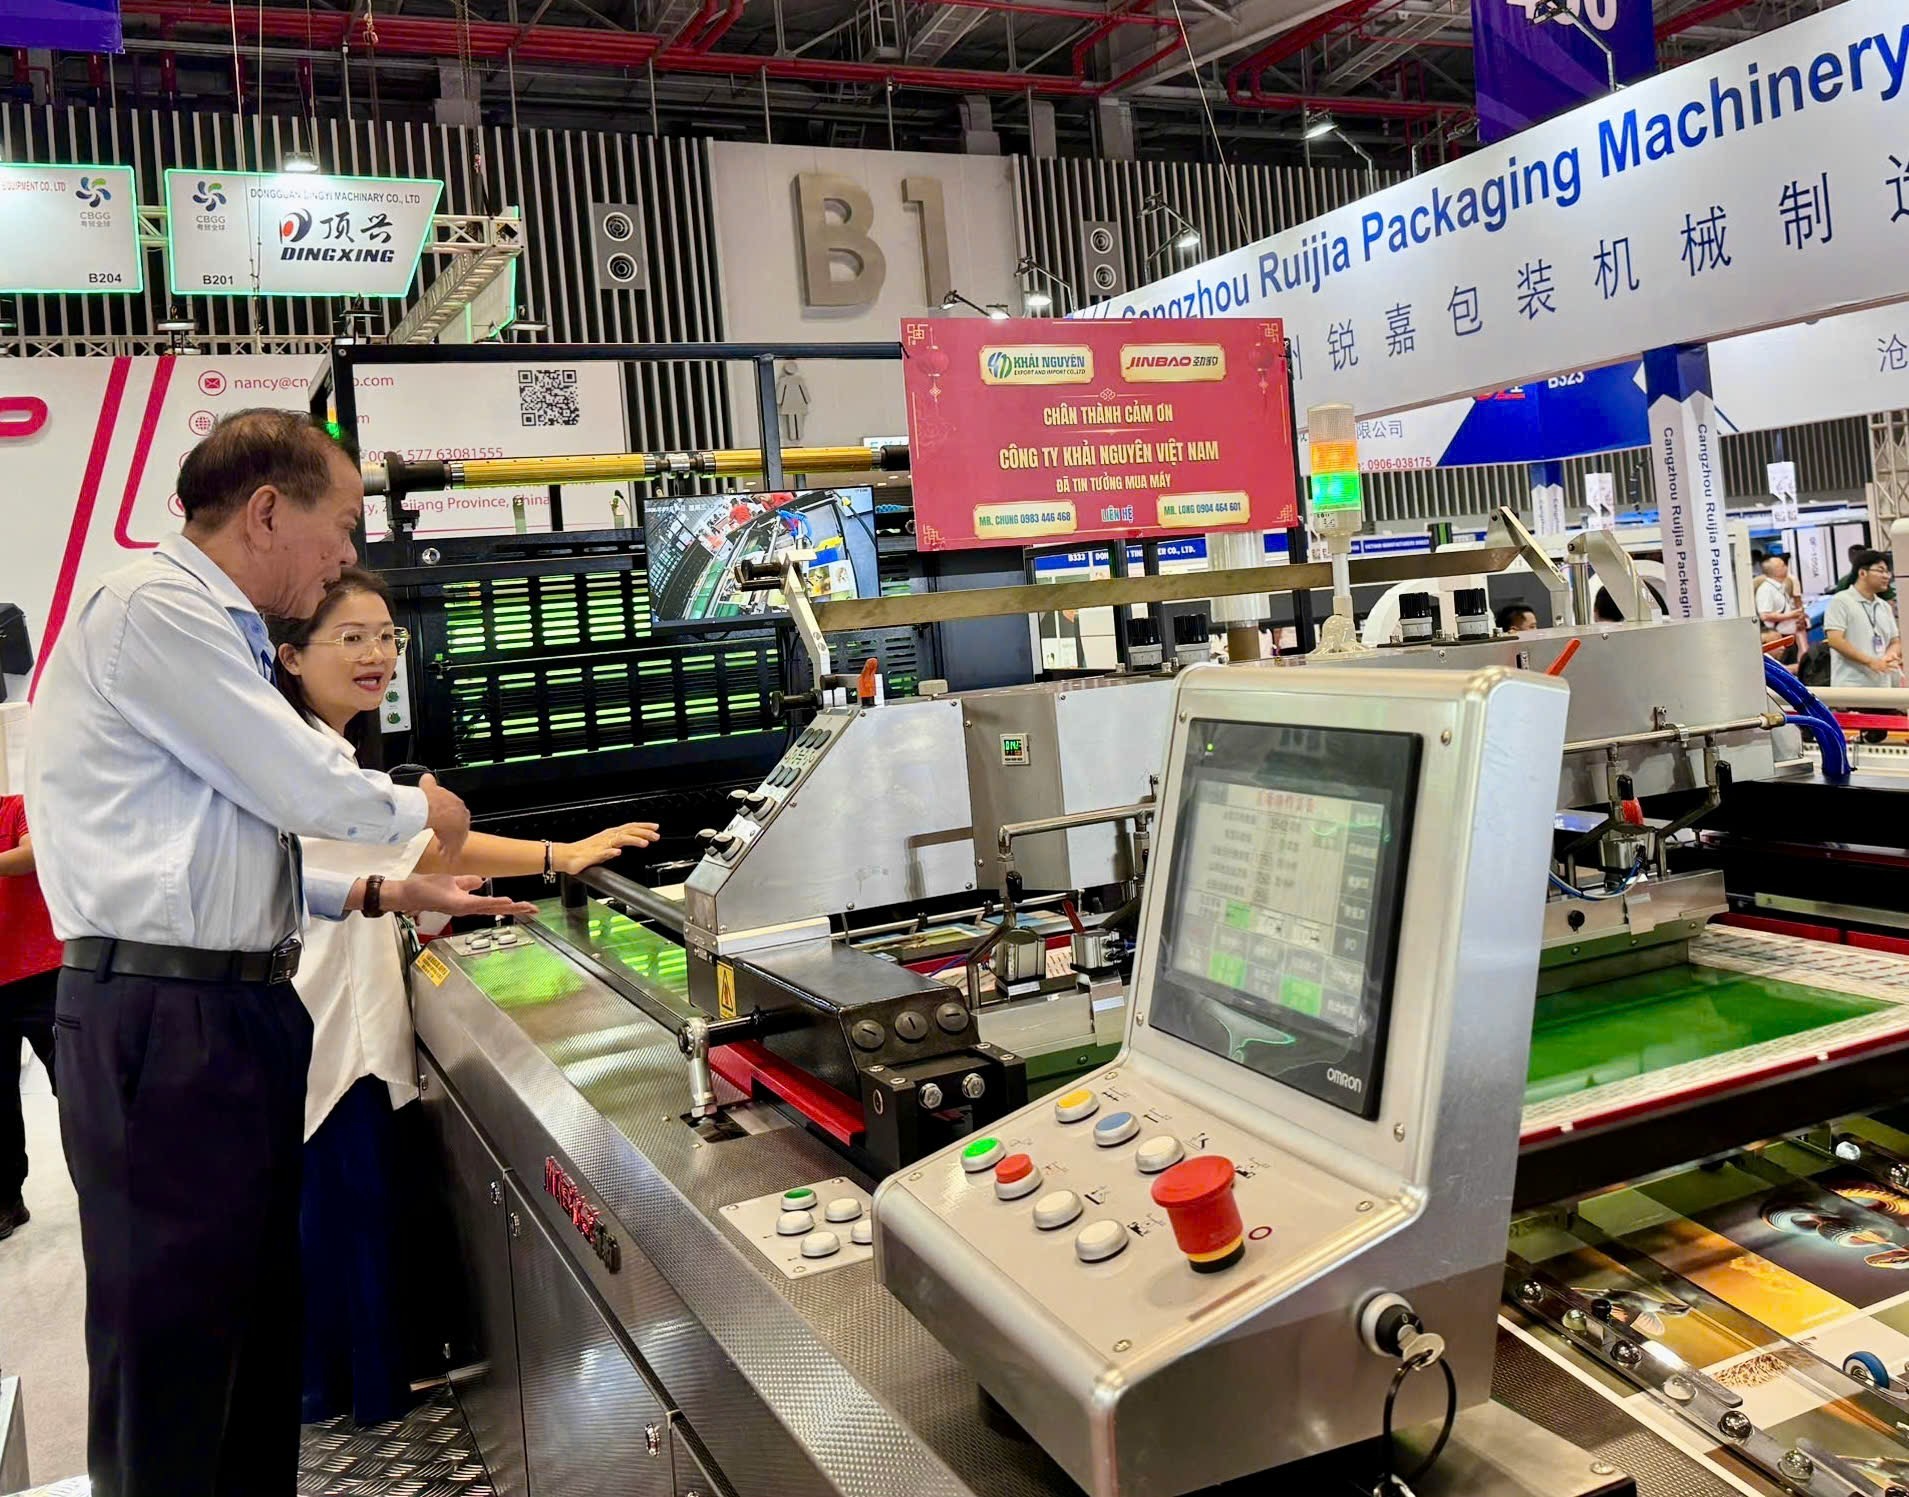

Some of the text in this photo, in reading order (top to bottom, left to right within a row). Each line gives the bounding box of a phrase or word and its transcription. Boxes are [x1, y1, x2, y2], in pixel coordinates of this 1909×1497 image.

[1258, 231, 1352, 294] Ruijia
[1362, 147, 1582, 262] Packaging
[1599, 24, 1909, 178] Machinery
[54, 181, 66, 192] LTD
[334, 192, 385, 204] MACHINARY
[404, 195, 421, 204] LTD
[80, 212, 111, 220] CBGG
[196, 215, 226, 224] CBGG
[790, 173, 951, 307] B1
[280, 246, 395, 263] DINGXING
[88, 273, 122, 283] B204
[202, 274, 234, 285] B201
[1042, 353, 1085, 368] NGUYÊN
[1125, 356, 1192, 370] JINBAO
[1043, 400, 1173, 425] CHÂN THÀNH CẢM ƠN
[407, 448, 432, 461] 577
[436, 447, 504, 461] 63081555
[999, 438, 1219, 470] CÔNG TY KHẢI NGUYÊN VIỆT NAM
[1367, 456, 1432, 470] 0906-038175
[1056, 471, 1171, 493] ĐÃ TIN TƯỞNG MUA MÁY
[1663, 427, 1678, 501] Cangzhou
[1671, 505, 1684, 547] Ruijia
[1697, 423, 1713, 498] Cangzhou
[1705, 502, 1719, 544] Ruijia
[447, 496, 509, 511] Province,
[1163, 501, 1241, 516] MR. LONG 0904 464 601
[979, 511, 1071, 527] MR. CHUNG 0983 446 468
[1101, 504, 1134, 523] LIÊN HỆ
